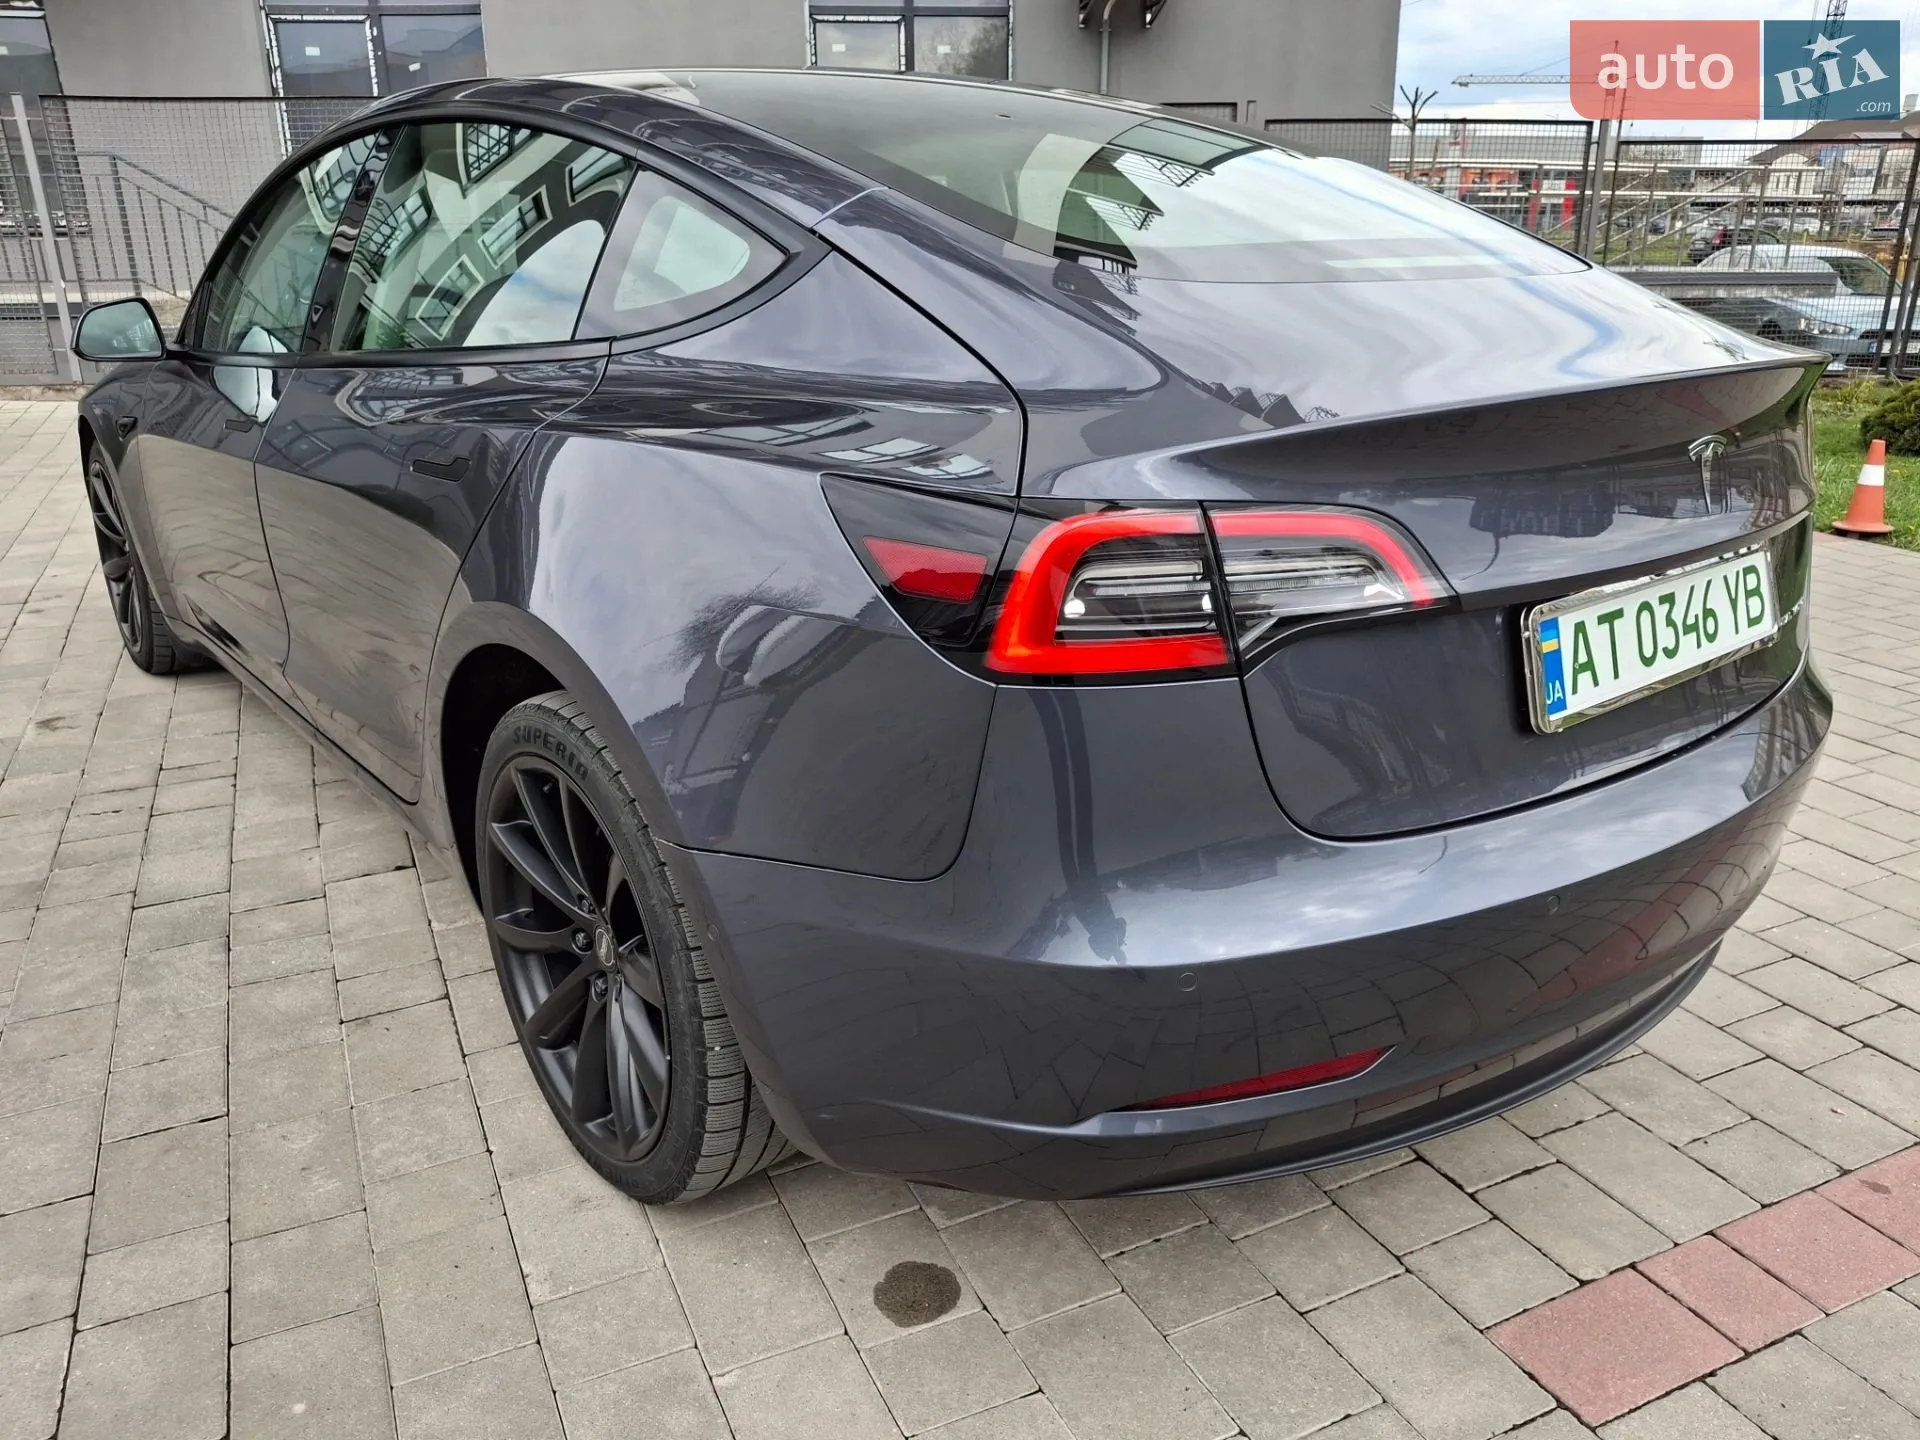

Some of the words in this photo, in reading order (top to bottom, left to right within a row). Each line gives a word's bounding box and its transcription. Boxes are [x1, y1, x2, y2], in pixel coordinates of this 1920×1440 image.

[1571, 607, 1624, 695] AT
[1635, 578, 1719, 667] 0346
[1723, 564, 1765, 635] YB
